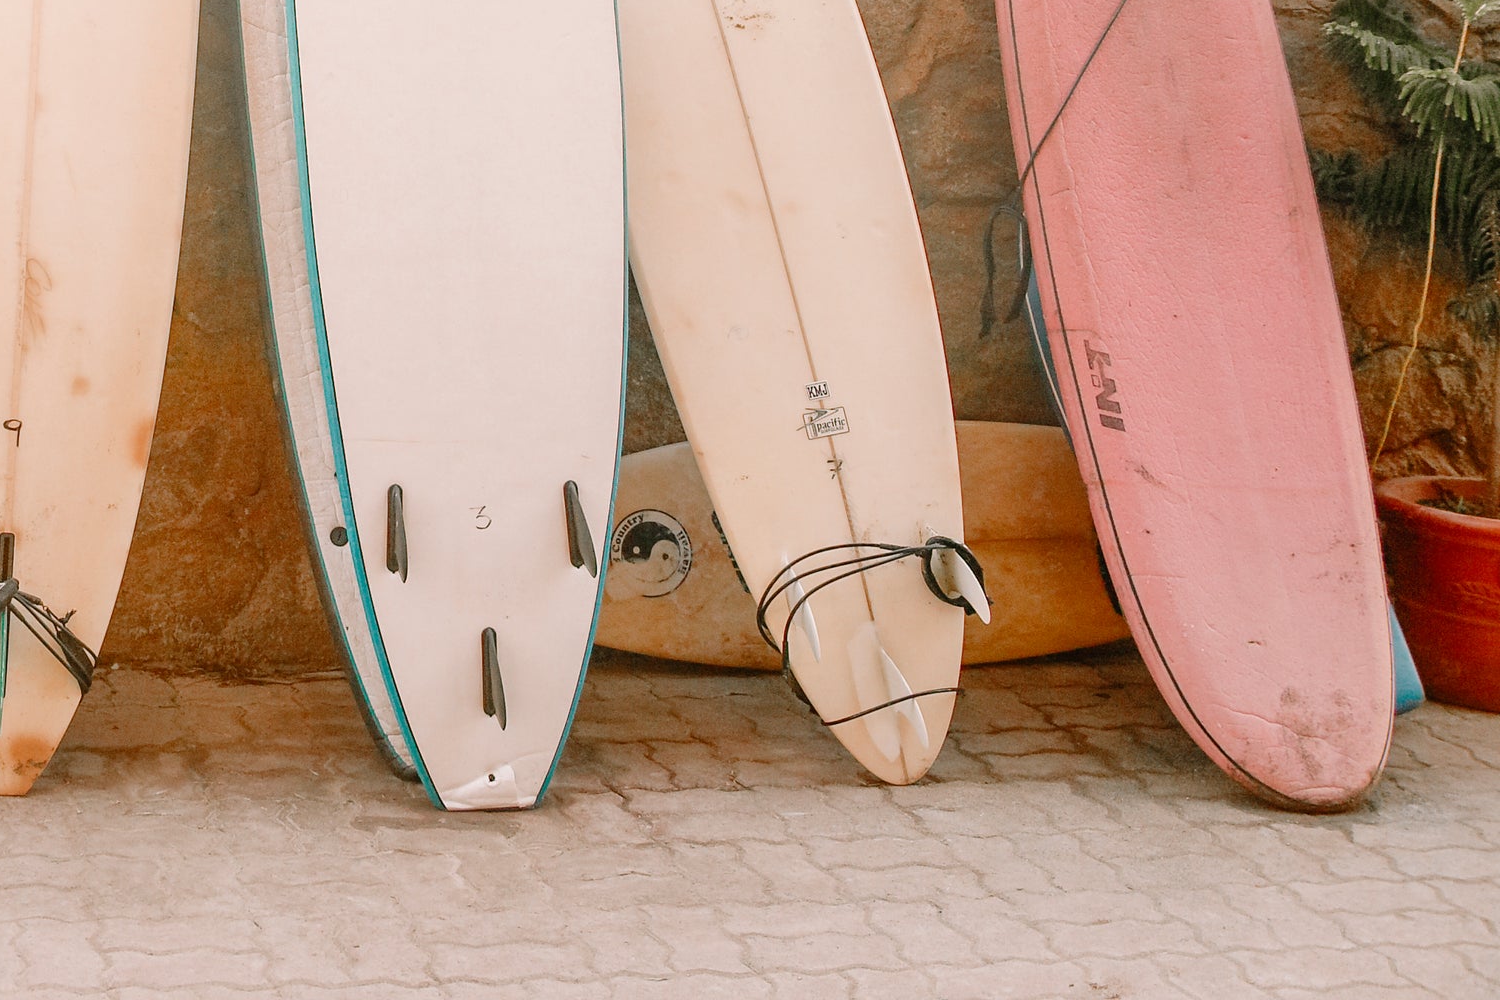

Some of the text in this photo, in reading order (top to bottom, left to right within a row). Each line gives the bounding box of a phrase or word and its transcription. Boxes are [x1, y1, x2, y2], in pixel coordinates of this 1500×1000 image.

[807, 383, 829, 399] KMJ
[3, 418, 23, 448] 9
[816, 417, 846, 433] pacific
[468, 505, 493, 530] 3
[611, 513, 645, 554] Country
